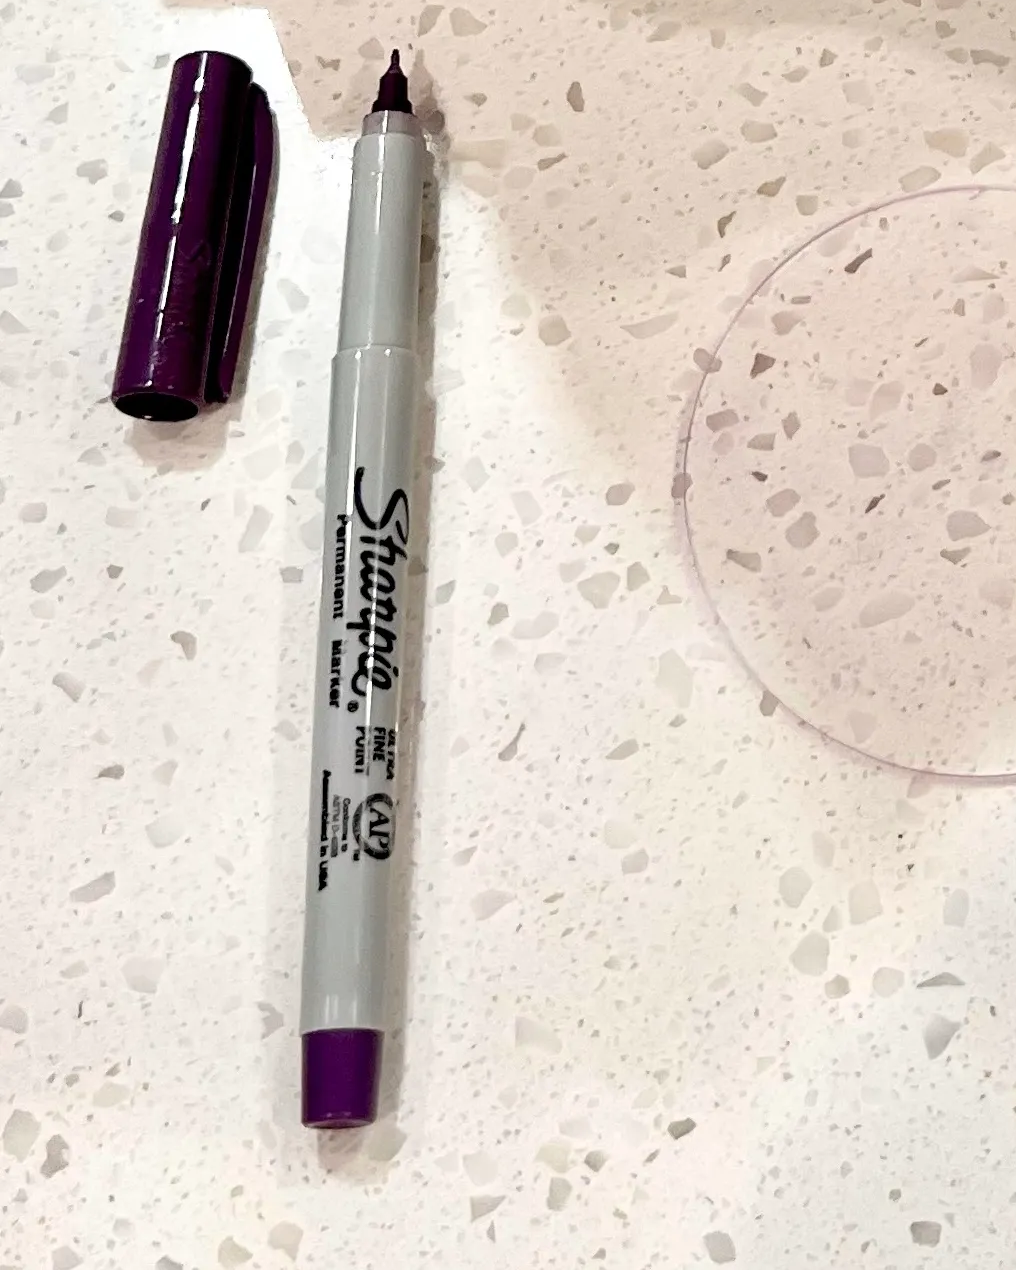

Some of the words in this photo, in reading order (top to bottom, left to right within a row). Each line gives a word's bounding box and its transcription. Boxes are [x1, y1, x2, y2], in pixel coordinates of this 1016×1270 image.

[333, 515, 347, 620] Permanent
[347, 467, 409, 696] Sharpie
[330, 640, 345, 708] Marker
[373, 727, 386, 762] FINE
[321, 770, 331, 841] Abled
[369, 808, 390, 849] AP
